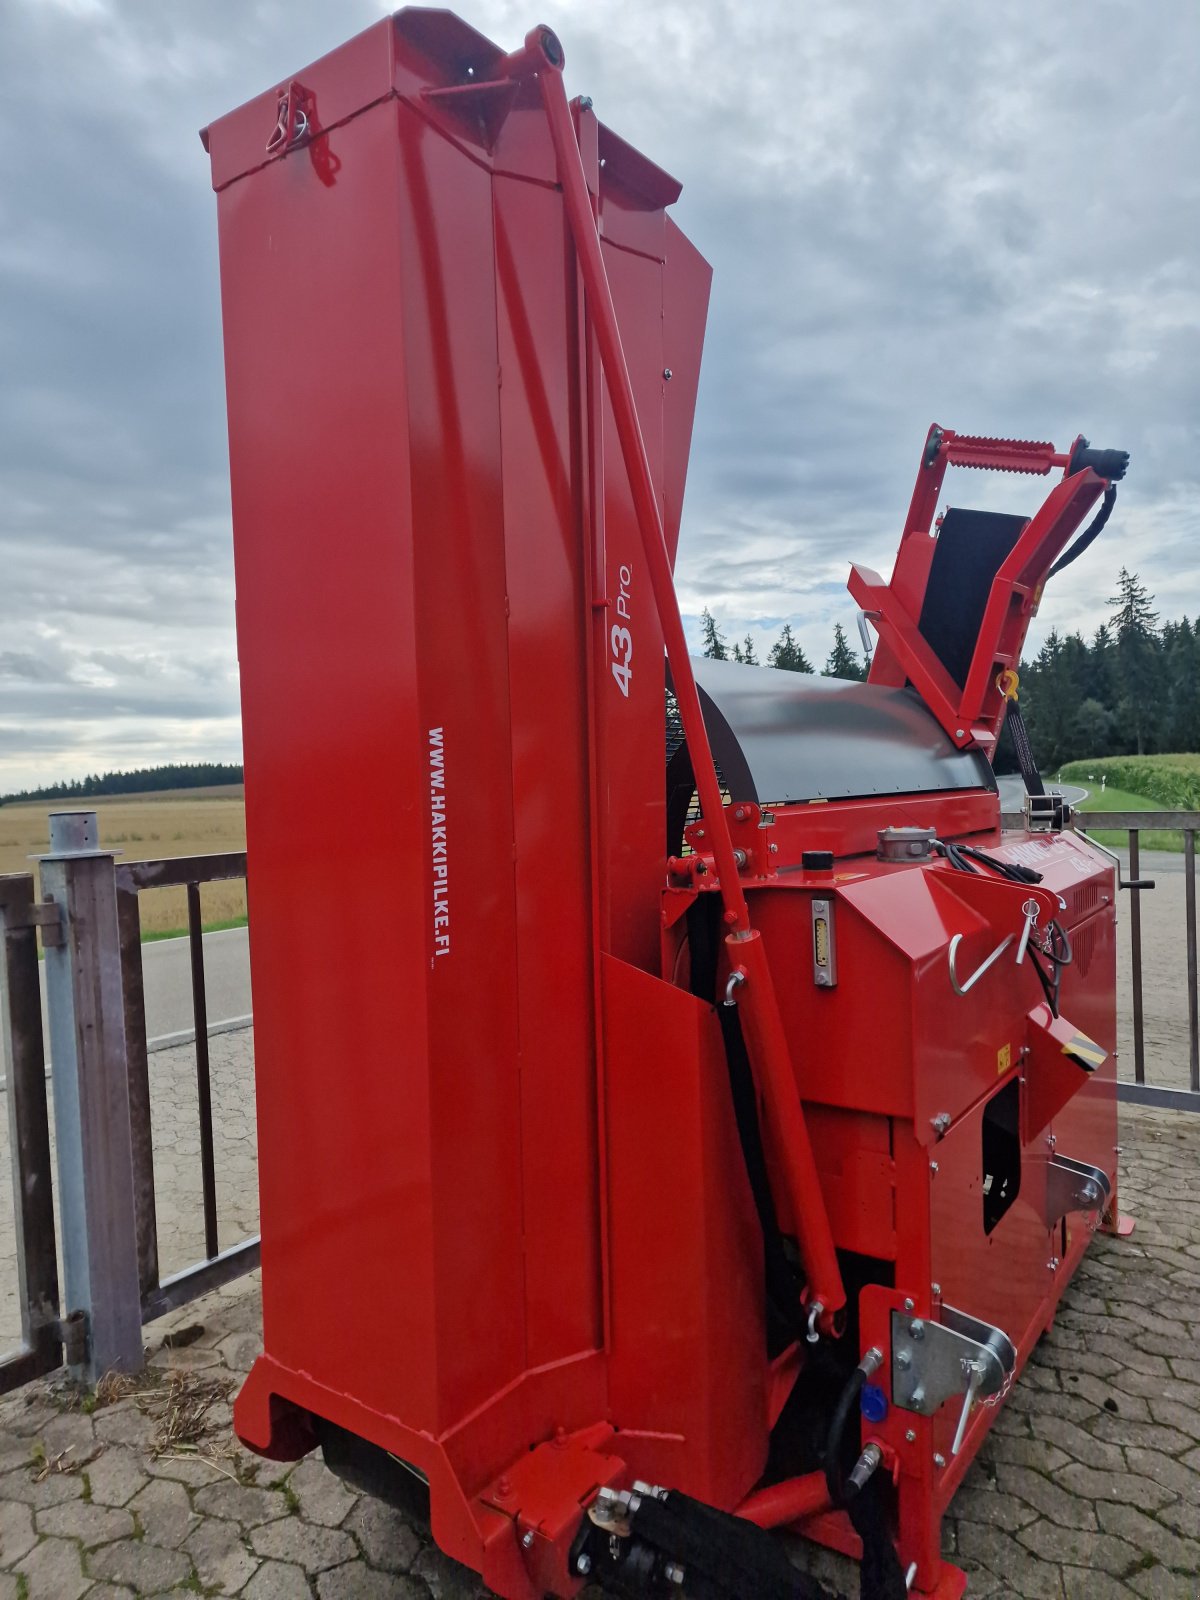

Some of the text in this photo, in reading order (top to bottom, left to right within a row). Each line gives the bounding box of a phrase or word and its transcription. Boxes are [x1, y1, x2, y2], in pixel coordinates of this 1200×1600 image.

[611, 565, 633, 698] 43 Pro
[428, 727, 450, 956] WWW.HAKKIPILKE.FI
